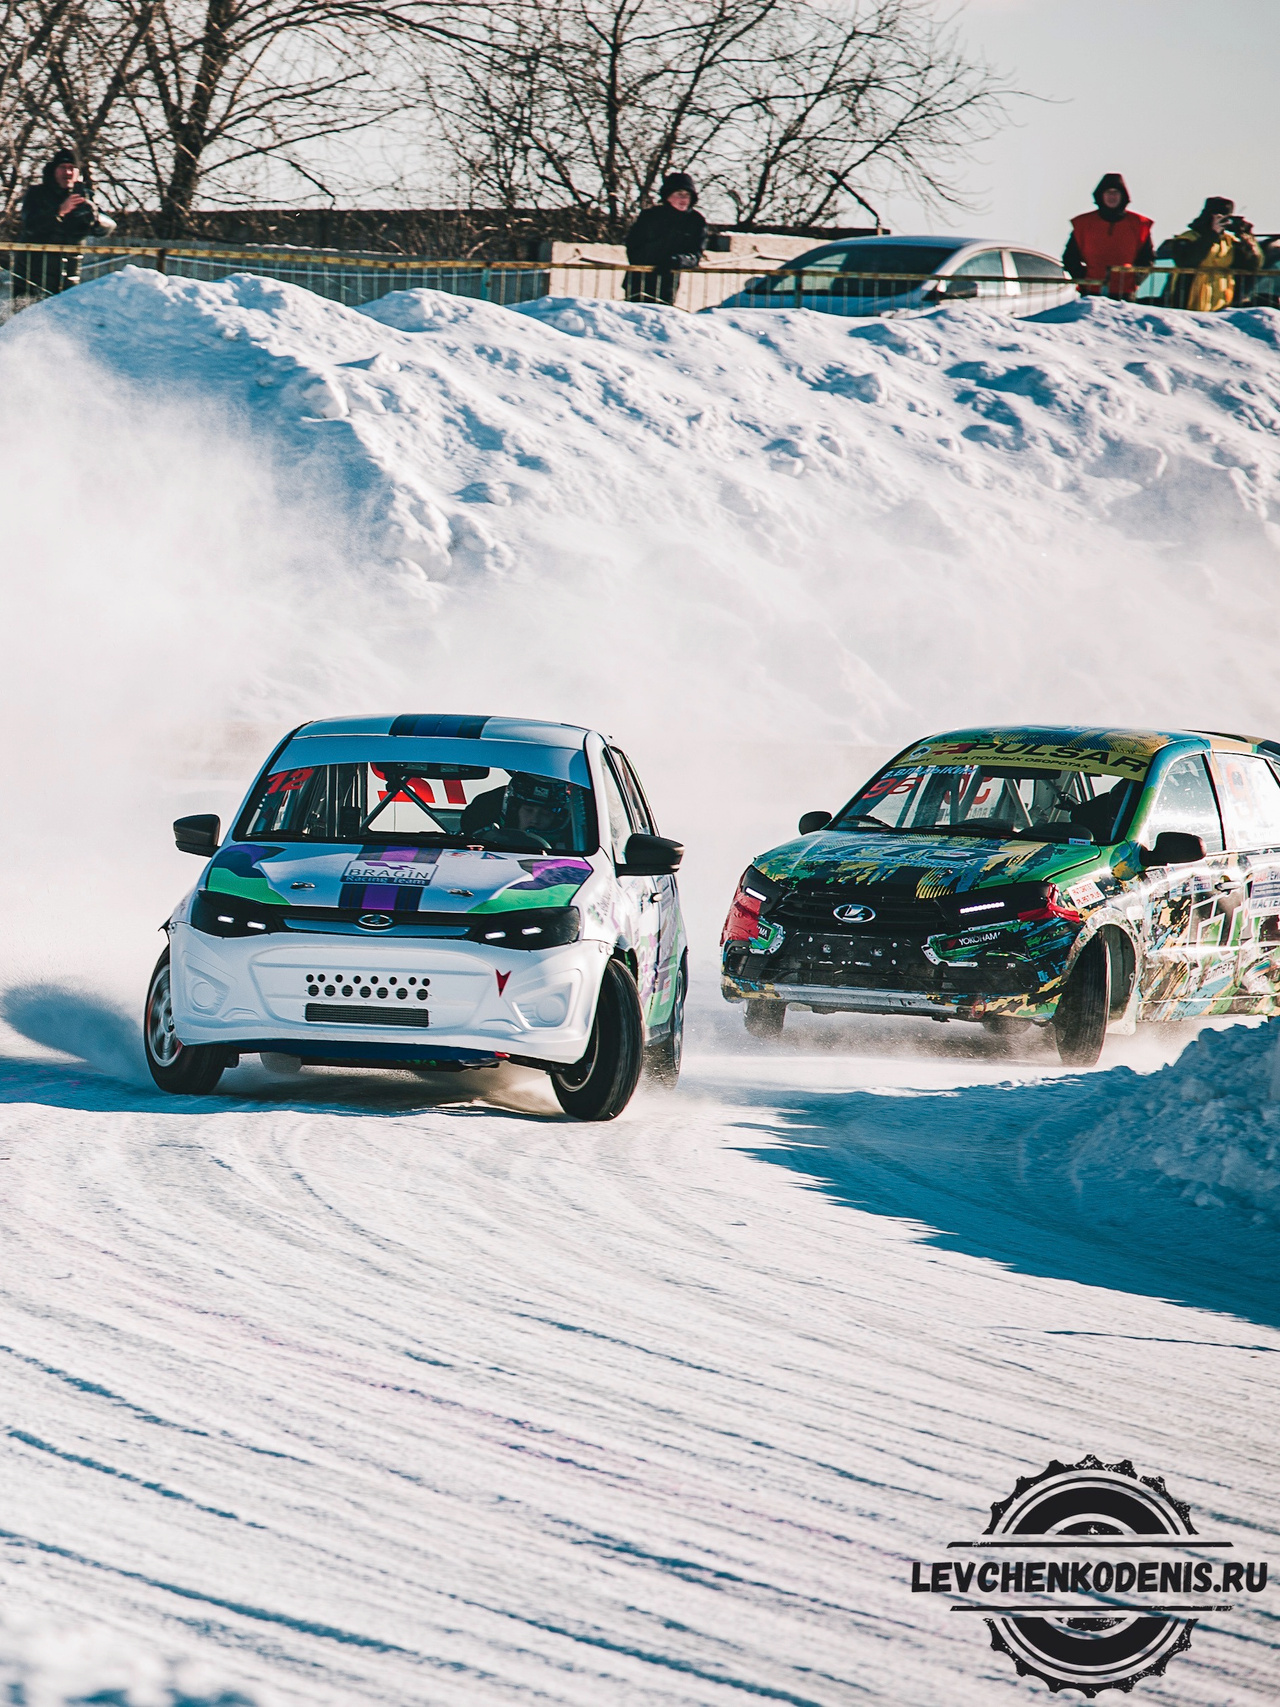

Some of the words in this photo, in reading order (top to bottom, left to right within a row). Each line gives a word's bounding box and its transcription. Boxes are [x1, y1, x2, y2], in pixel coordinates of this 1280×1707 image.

[964, 742, 1149, 773] PULSAR
[972, 754, 1022, 762] ПОЛНЫХ
[1024, 757, 1090, 769] ОБОРОТАХ
[267, 767, 314, 794] 12
[862, 777, 923, 799] 96
[346, 875, 388, 883] Racing
[393, 877, 426, 885] Team
[349, 868, 429, 879] BRAGIN
